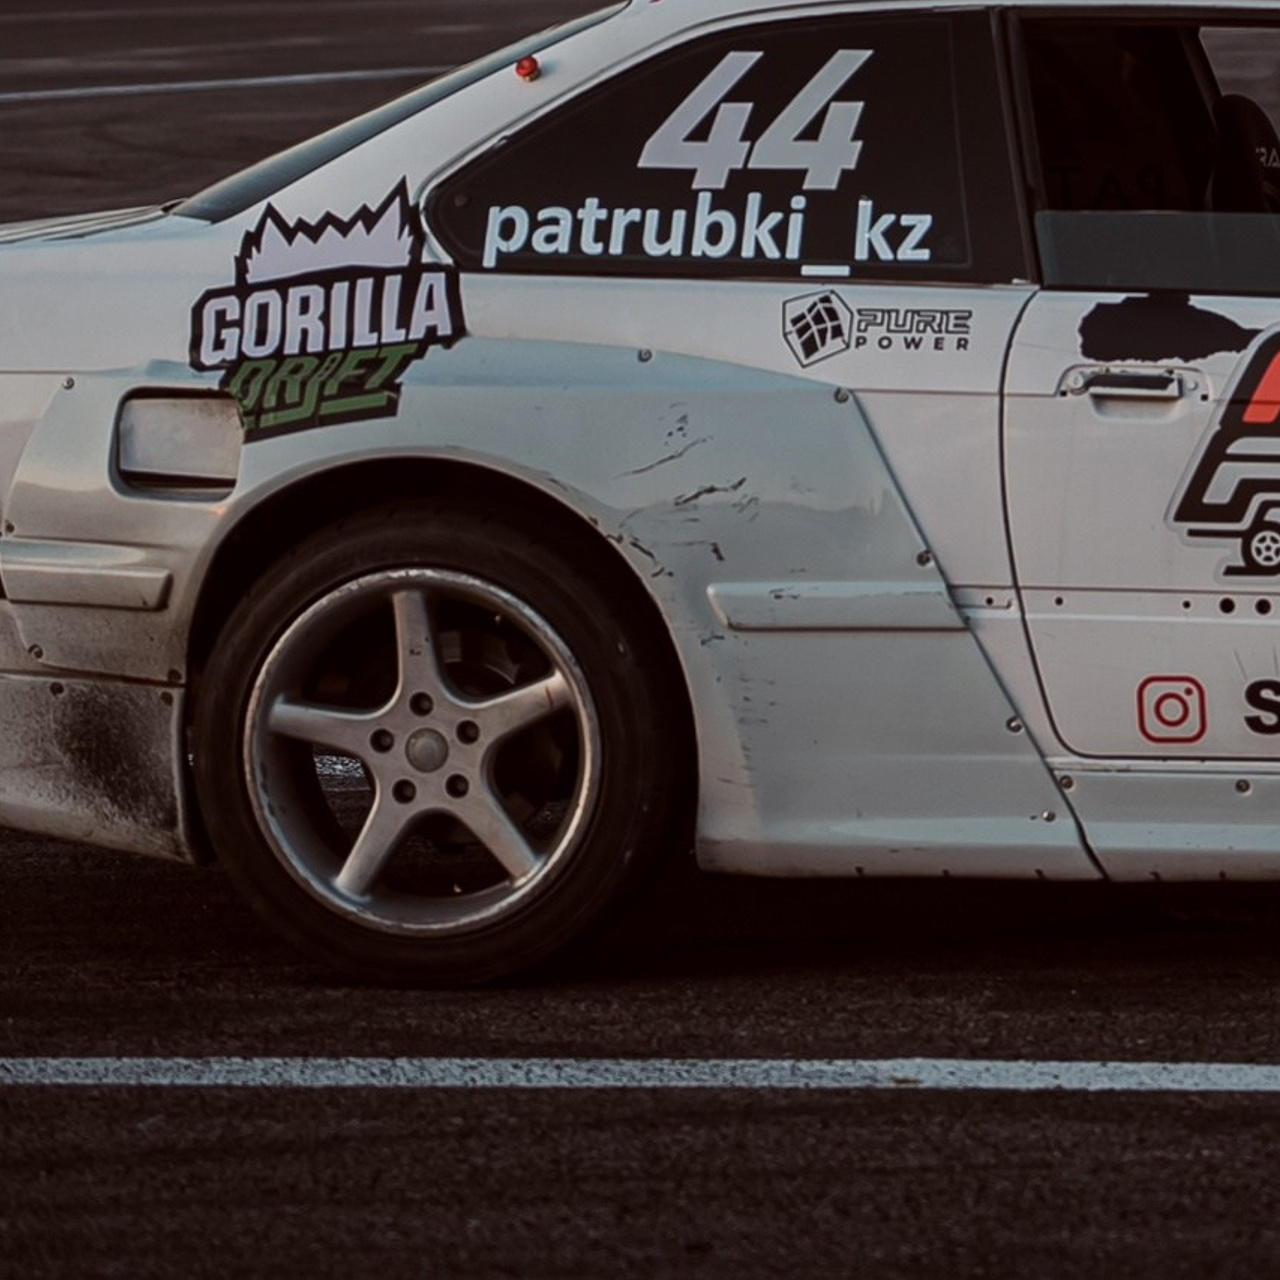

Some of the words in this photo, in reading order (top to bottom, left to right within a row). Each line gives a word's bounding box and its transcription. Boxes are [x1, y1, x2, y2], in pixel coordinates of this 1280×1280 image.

[637, 49, 874, 189] 44
[482, 191, 933, 277] patrubki_kz
[200, 271, 453, 367] GORILLA
[855, 336, 970, 351] POWER
[856, 308, 973, 335] PURE
[228, 342, 420, 429] DRIFT
